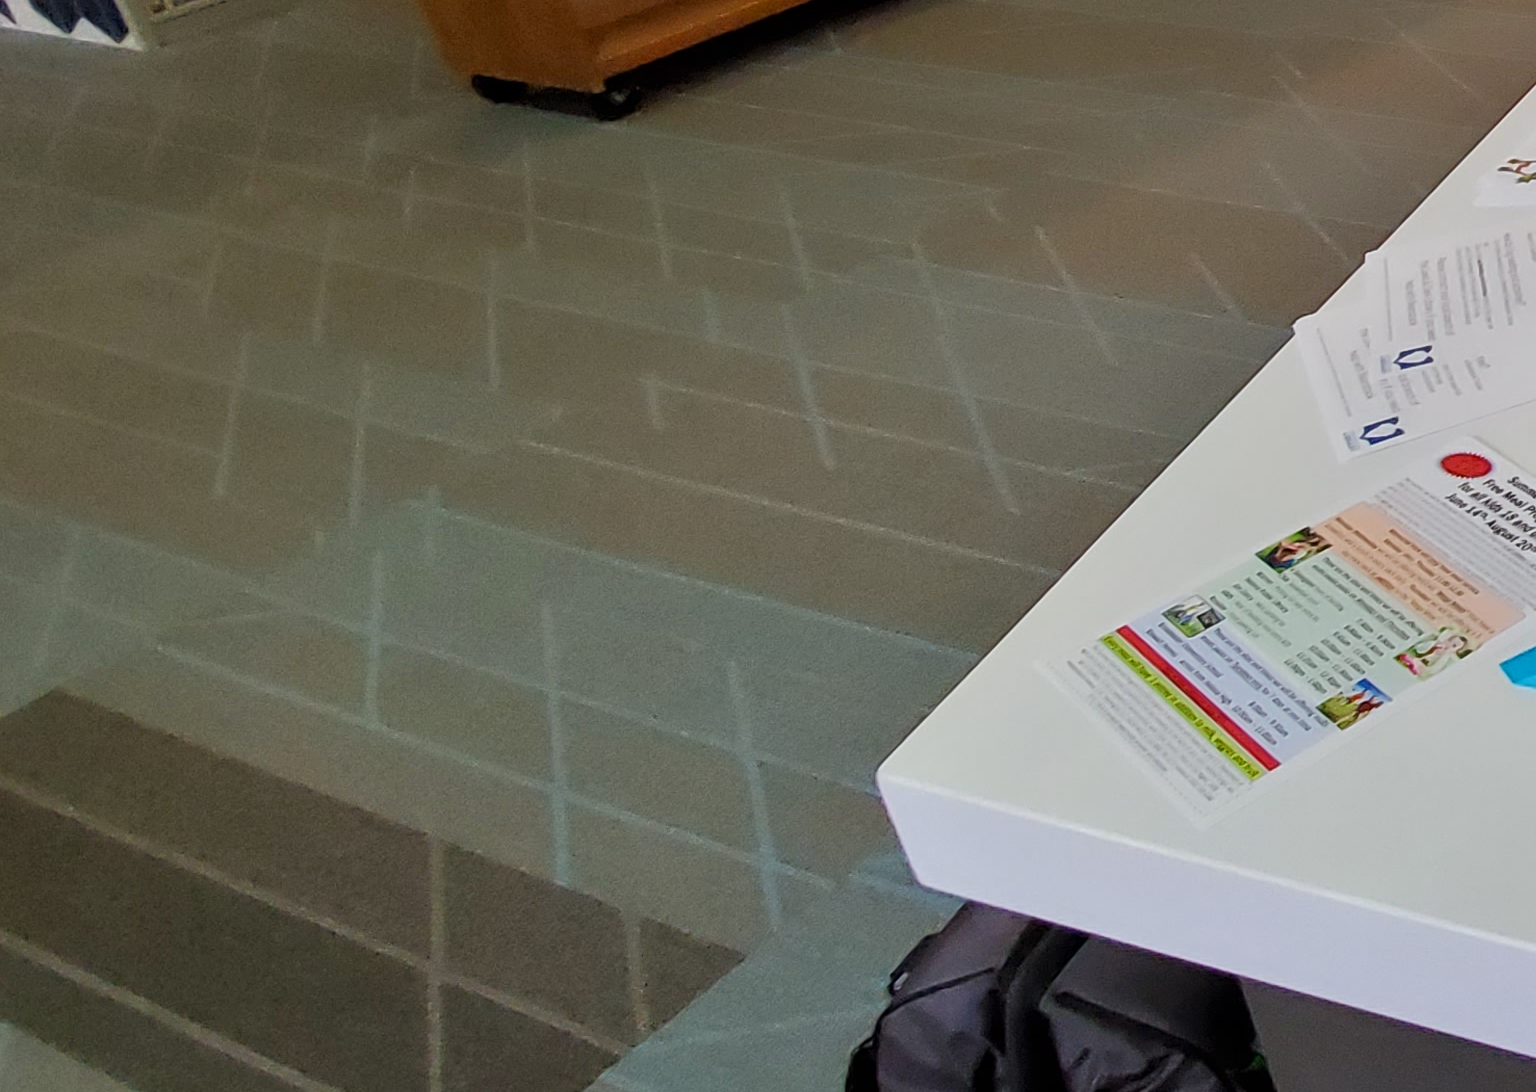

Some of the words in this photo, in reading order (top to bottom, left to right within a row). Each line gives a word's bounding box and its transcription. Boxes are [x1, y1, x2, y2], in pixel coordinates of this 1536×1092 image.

[1445, 493, 1469, 510] June
[1486, 518, 1518, 544] August
[1457, 481, 1475, 495] for
[1470, 487, 1484, 504] all
[1513, 516, 1533, 534] and
[1482, 478, 1503, 495] Free
[1503, 490, 1527, 511] Meal
